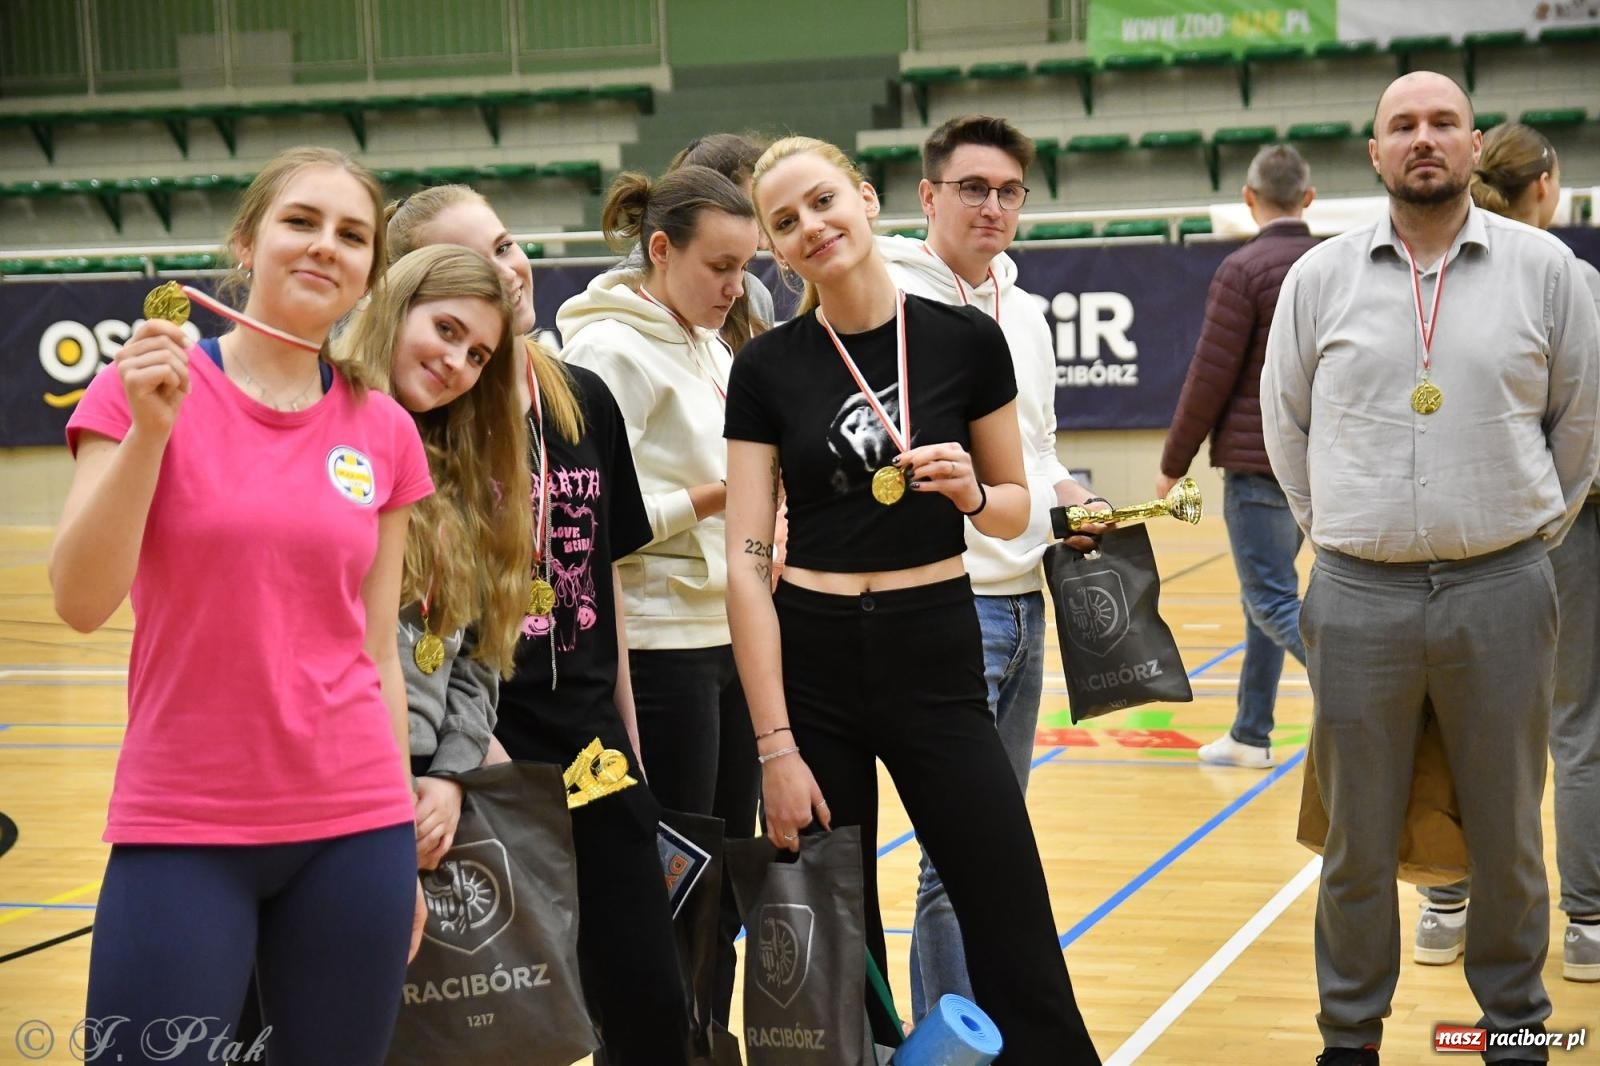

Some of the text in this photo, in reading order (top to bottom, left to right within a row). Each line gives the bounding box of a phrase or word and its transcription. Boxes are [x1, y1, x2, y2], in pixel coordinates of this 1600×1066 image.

[1030, 291, 1138, 361] iR
[402, 962, 551, 1005] RACIBÓRZ
[466, 1013, 495, 1028] 1217
[747, 1021, 825, 1050] RACIBÓRZ
